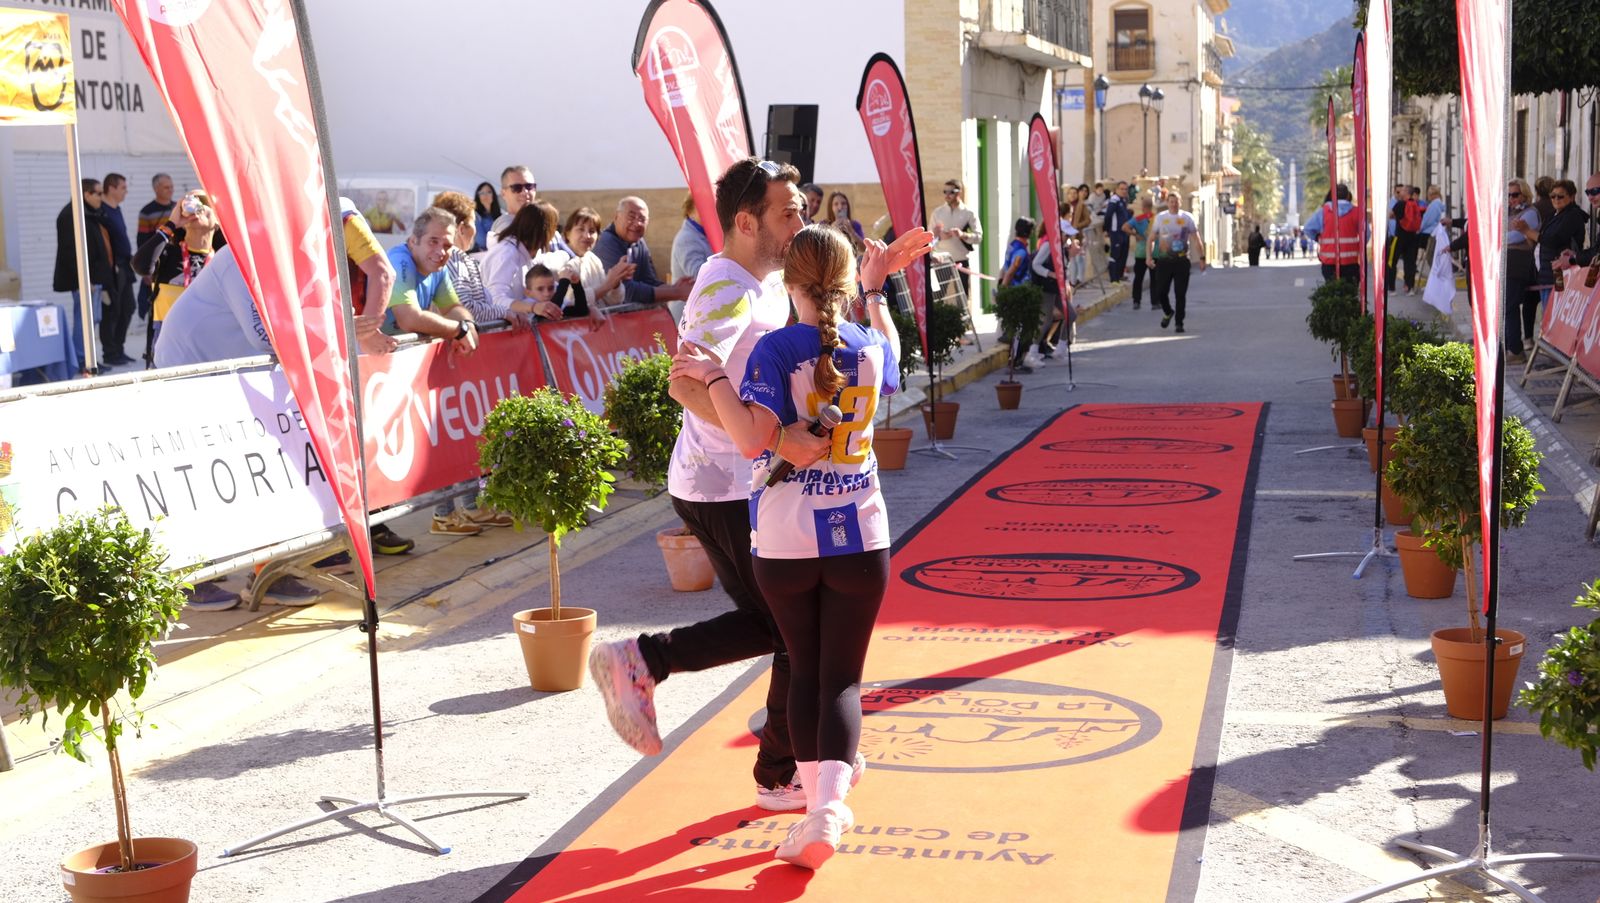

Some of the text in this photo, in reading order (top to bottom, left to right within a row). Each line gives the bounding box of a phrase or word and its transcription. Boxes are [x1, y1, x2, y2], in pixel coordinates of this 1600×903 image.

[81, 29, 107, 60] DE
[74, 79, 145, 113] NTORIA
[49, 411, 307, 475] AYUNTAMIENTO DE
[882, 634, 1133, 649] Ayuntamiento
[911, 626, 1117, 639] de Cantoria
[1057, 701, 1114, 712] LA
[736, 818, 1030, 845] de Canria
[690, 836, 1055, 866] Ayuntamnto
